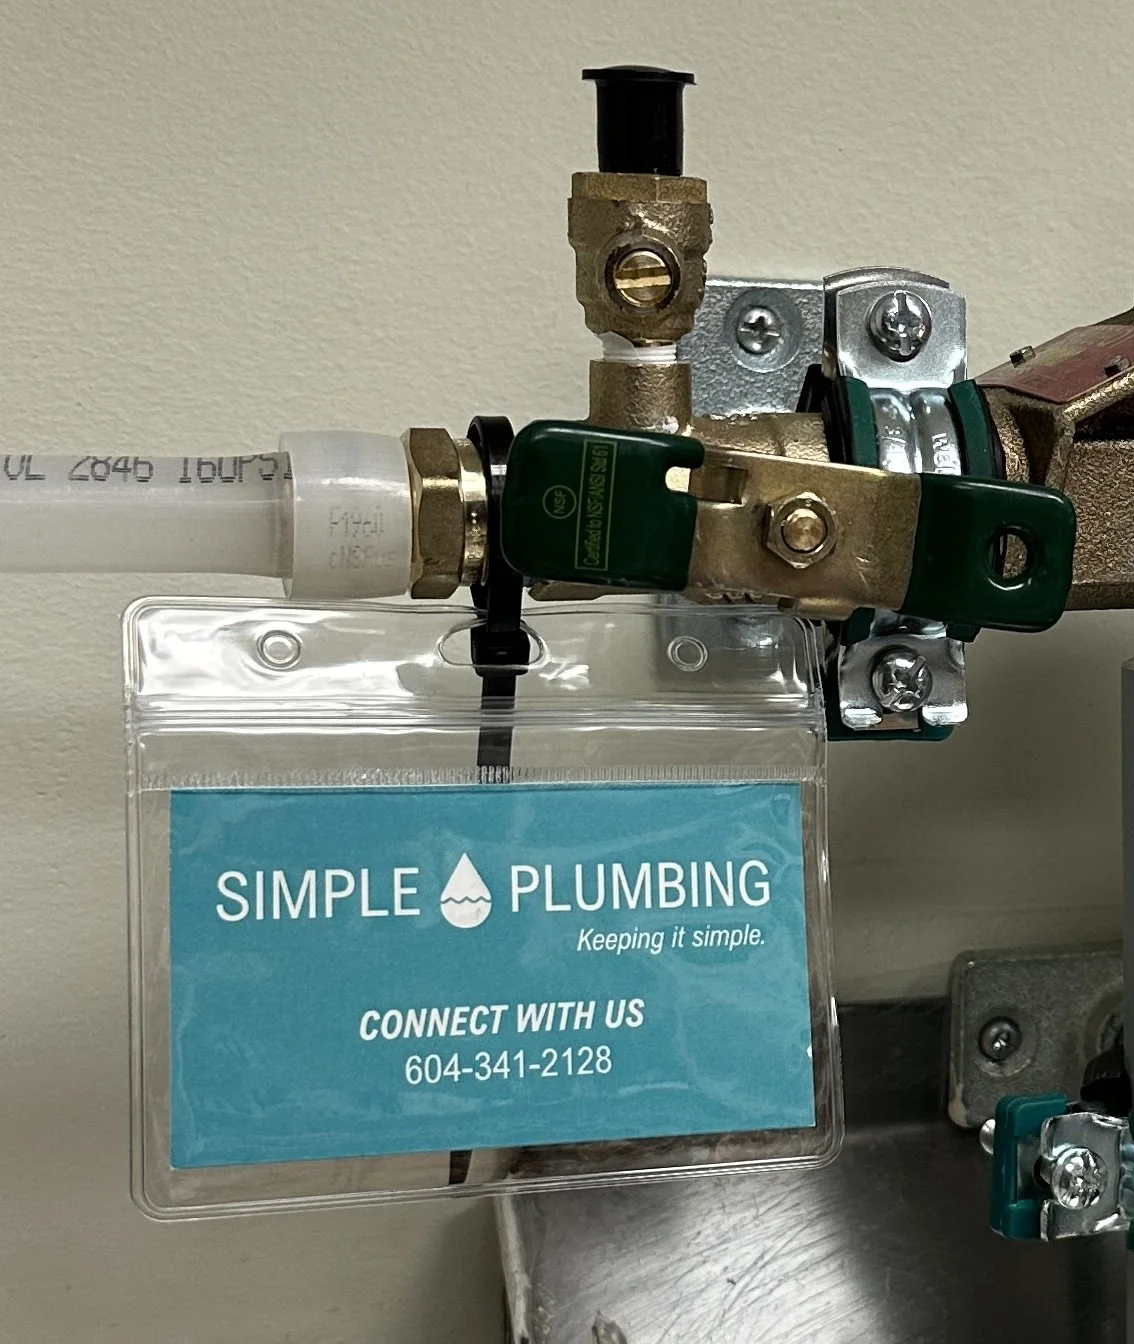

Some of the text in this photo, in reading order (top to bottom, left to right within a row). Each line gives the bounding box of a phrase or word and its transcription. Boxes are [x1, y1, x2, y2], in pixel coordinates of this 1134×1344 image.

[67, 455, 154, 483] 2846
[554, 491, 566, 514] NSF
[216, 860, 770, 922] SIMPLE PLUMBING
[577, 923, 765, 955] Keeping it simple.
[359, 998, 645, 1041] CONNECT WITH US
[405, 1045, 612, 1085] 604-341-2128
